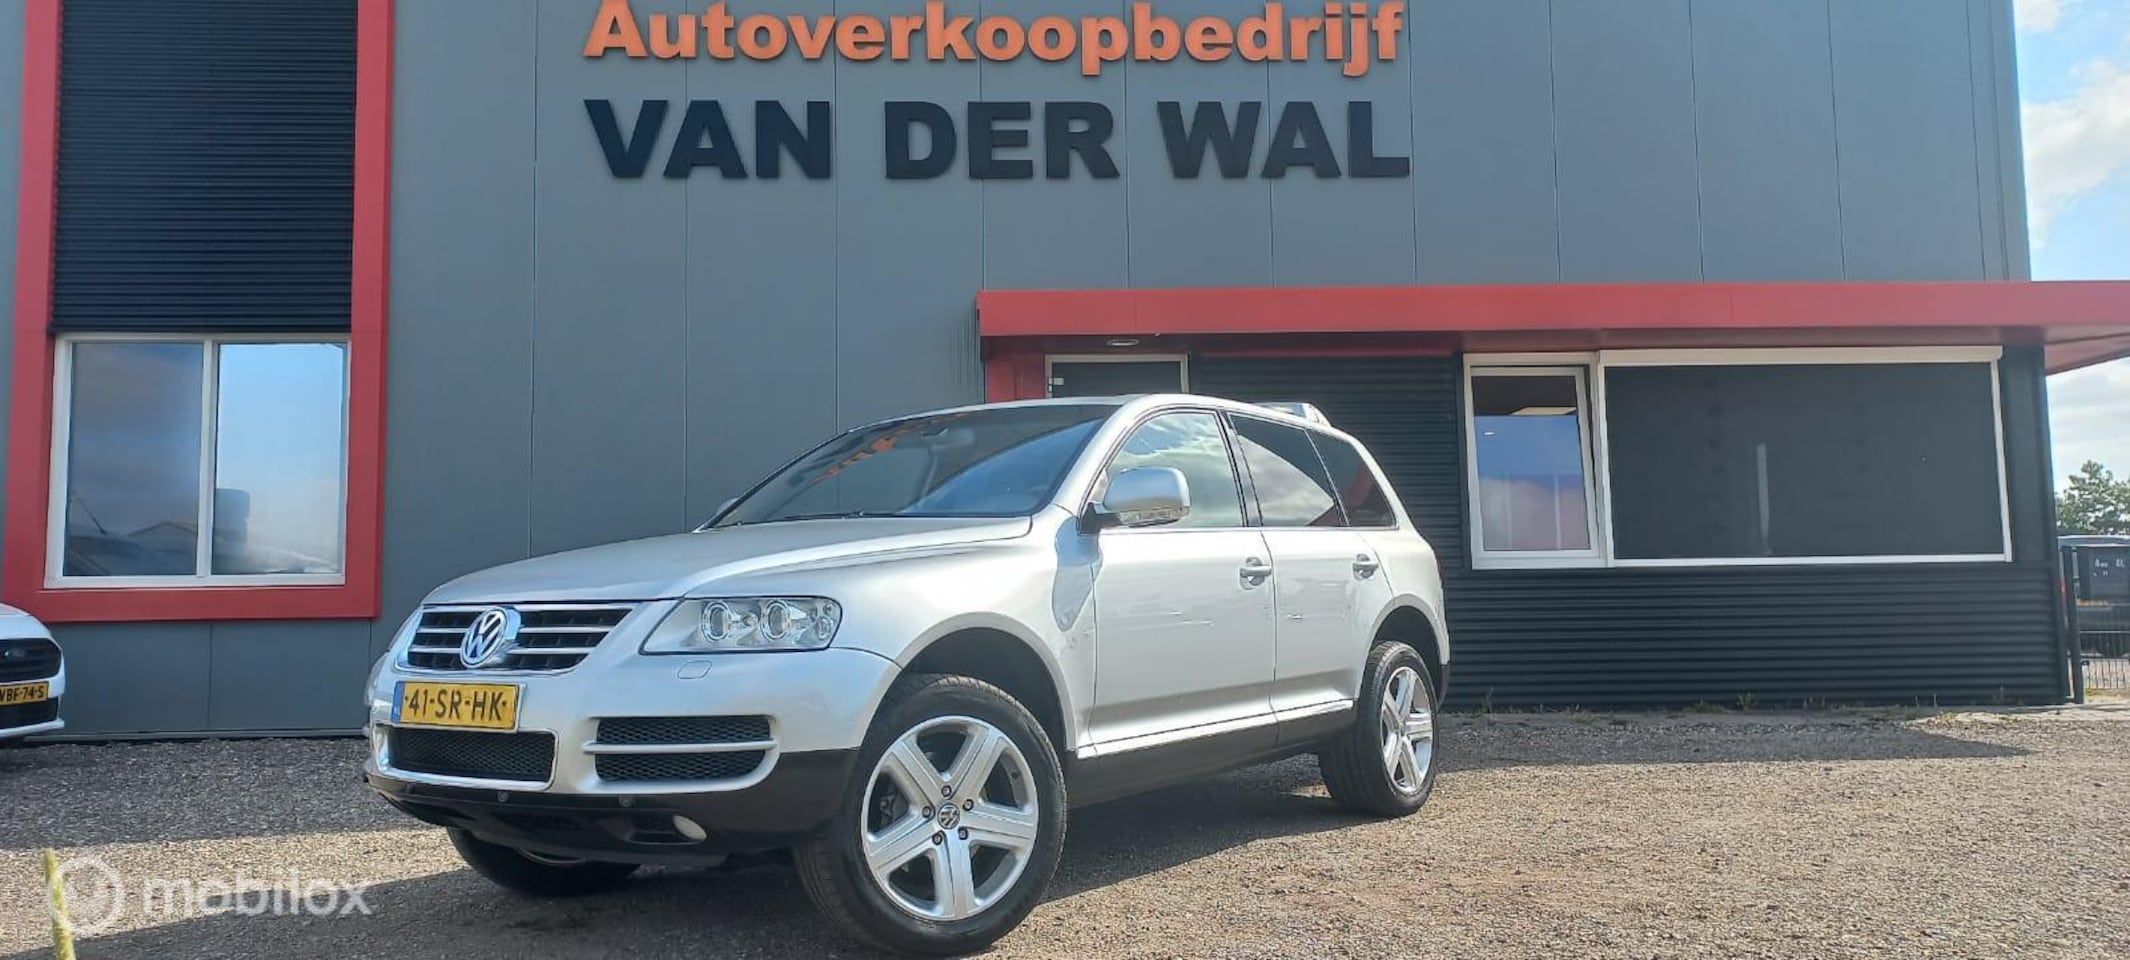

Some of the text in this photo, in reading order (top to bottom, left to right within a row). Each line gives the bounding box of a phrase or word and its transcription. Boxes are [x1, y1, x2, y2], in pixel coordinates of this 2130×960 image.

[583, 0, 1404, 77] Autoverkoopbedrijf
[583, 99, 1410, 179] VAN DER WAL
[407, 688, 506, 721] 41-SR-HK
